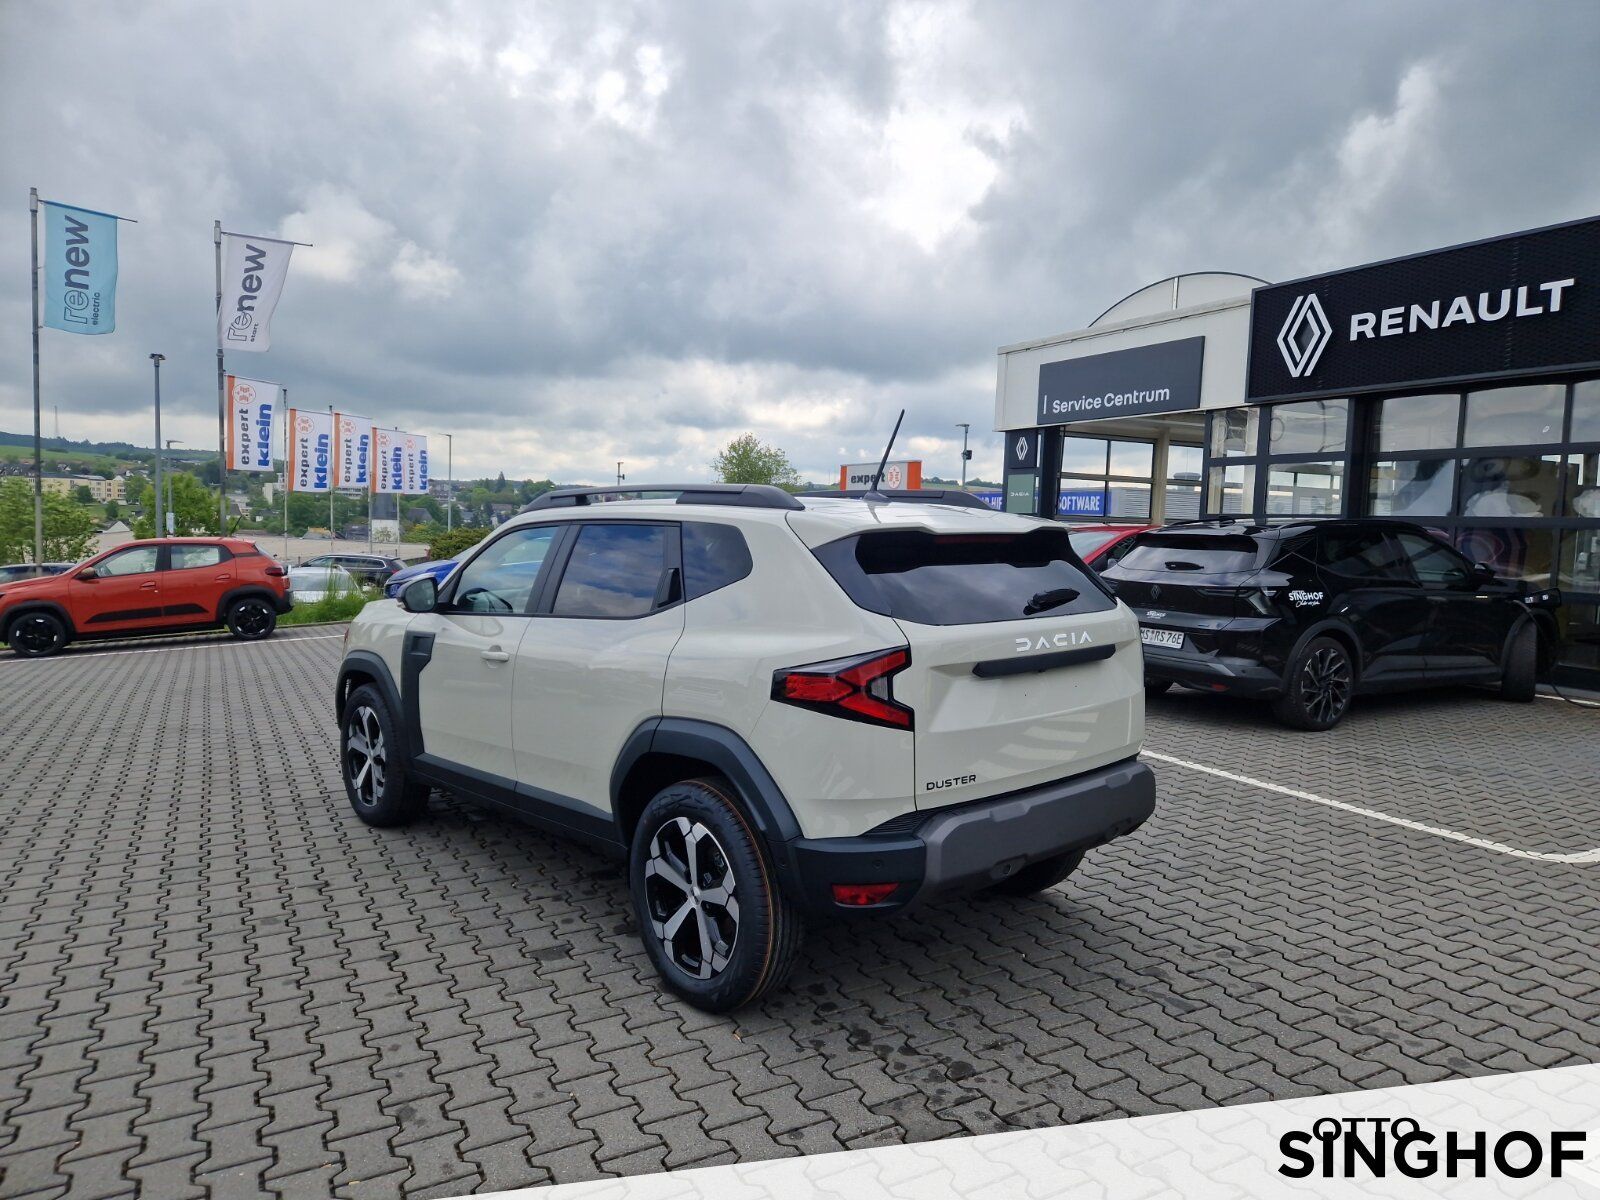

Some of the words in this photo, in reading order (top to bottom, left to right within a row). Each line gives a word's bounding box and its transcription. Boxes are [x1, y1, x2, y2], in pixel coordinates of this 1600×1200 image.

[64, 215, 90, 324] renew
[91, 292, 101, 325] electric
[227, 244, 267, 341] renew
[1349, 277, 1575, 342] RENAULT
[1052, 395, 1102, 414] Service
[1103, 388, 1170, 408] Centrum
[239, 408, 251, 465] expert
[256, 404, 272, 467] klein
[300, 437, 309, 487] expert
[314, 433, 328, 489] klein
[344, 438, 353, 483] expert
[356, 434, 369, 483] klein
[391, 446, 402, 490] klein
[419, 450, 427, 490] klein
[850, 472, 886, 485] expet
[1288, 592, 1324, 601] SINGHOF
[1015, 631, 1093, 652] DACIA
[1154, 631, 1166, 642] RS
[1167, 633, 1183, 645] 76E
[926, 774, 977, 791] DUSTER
